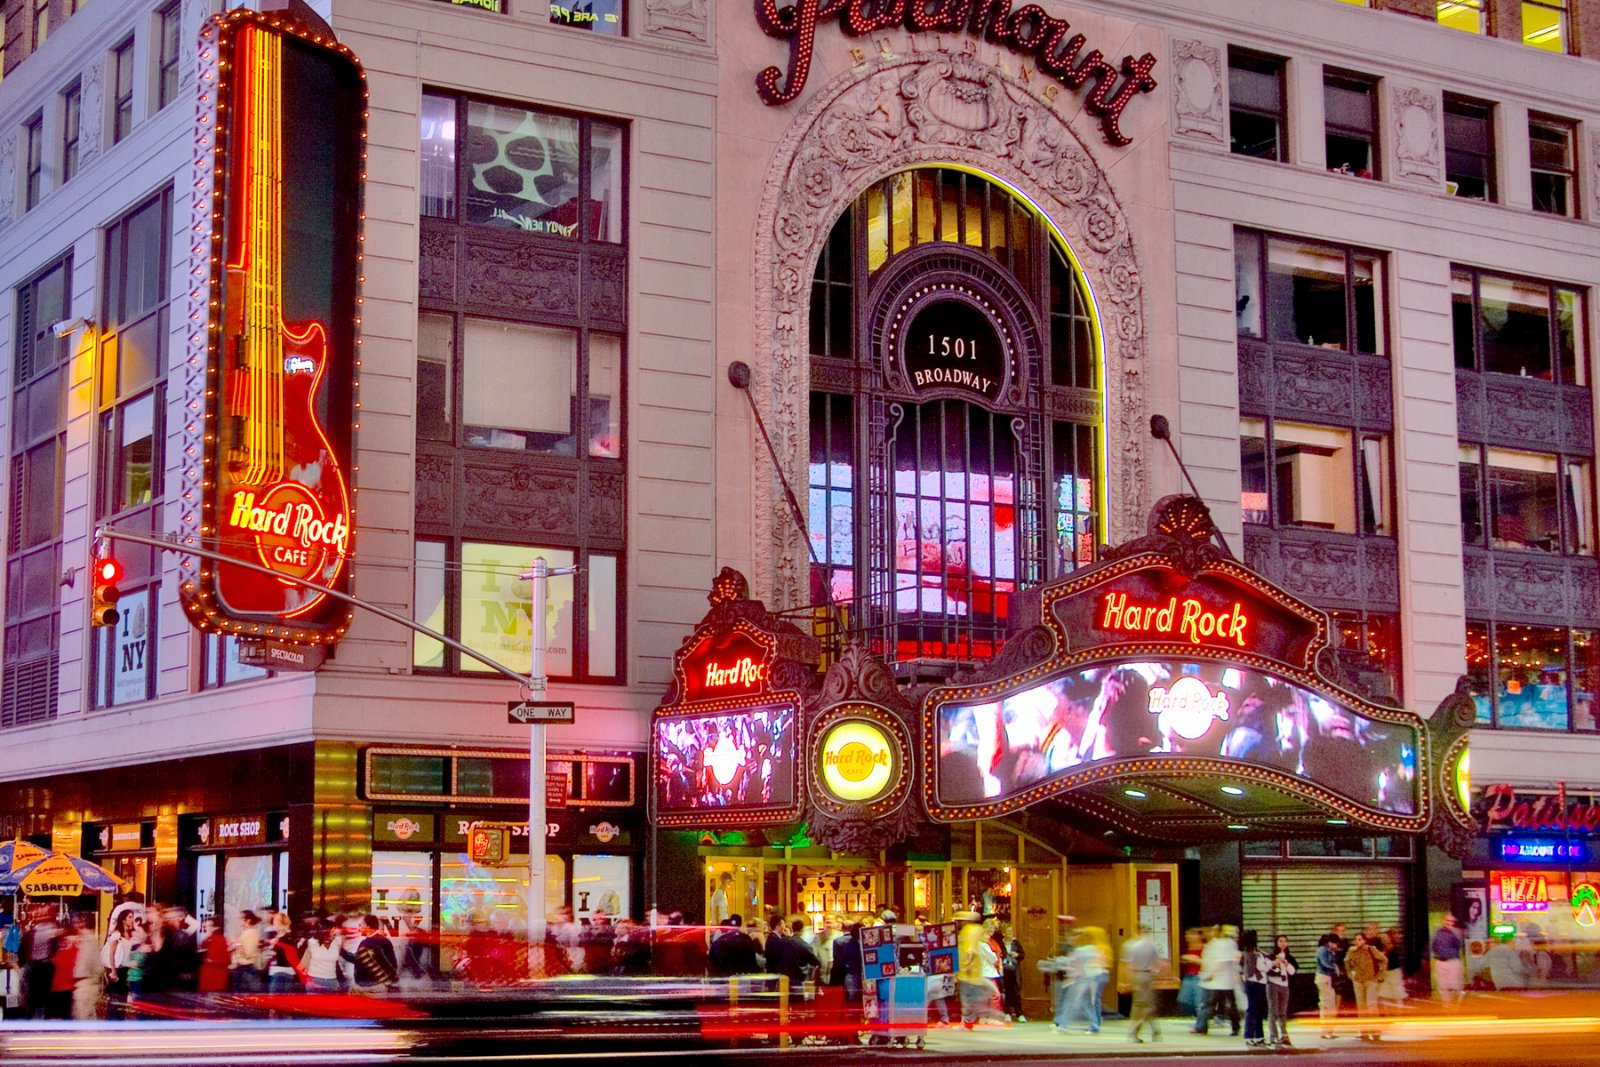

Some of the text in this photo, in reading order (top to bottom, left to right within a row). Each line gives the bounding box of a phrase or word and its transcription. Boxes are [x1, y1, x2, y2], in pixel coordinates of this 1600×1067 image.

[928, 334, 977, 360] 1501
[914, 367, 991, 393] BROADWAY
[230, 491, 347, 554] Hard Rock
[274, 546, 308, 566] CAFE
[1103, 592, 1247, 646] Hard Rock
[121, 640, 146, 673] NY
[705, 659, 741, 687] Hard
[516, 707, 567, 719] ONE WAY
[825, 749, 889, 766] Hard Rock
[219, 822, 239, 837] ROCK
[240, 821, 260, 836] SHOP
[25, 883, 79, 893] SABRETT
[1501, 875, 1548, 902] PIZZA
